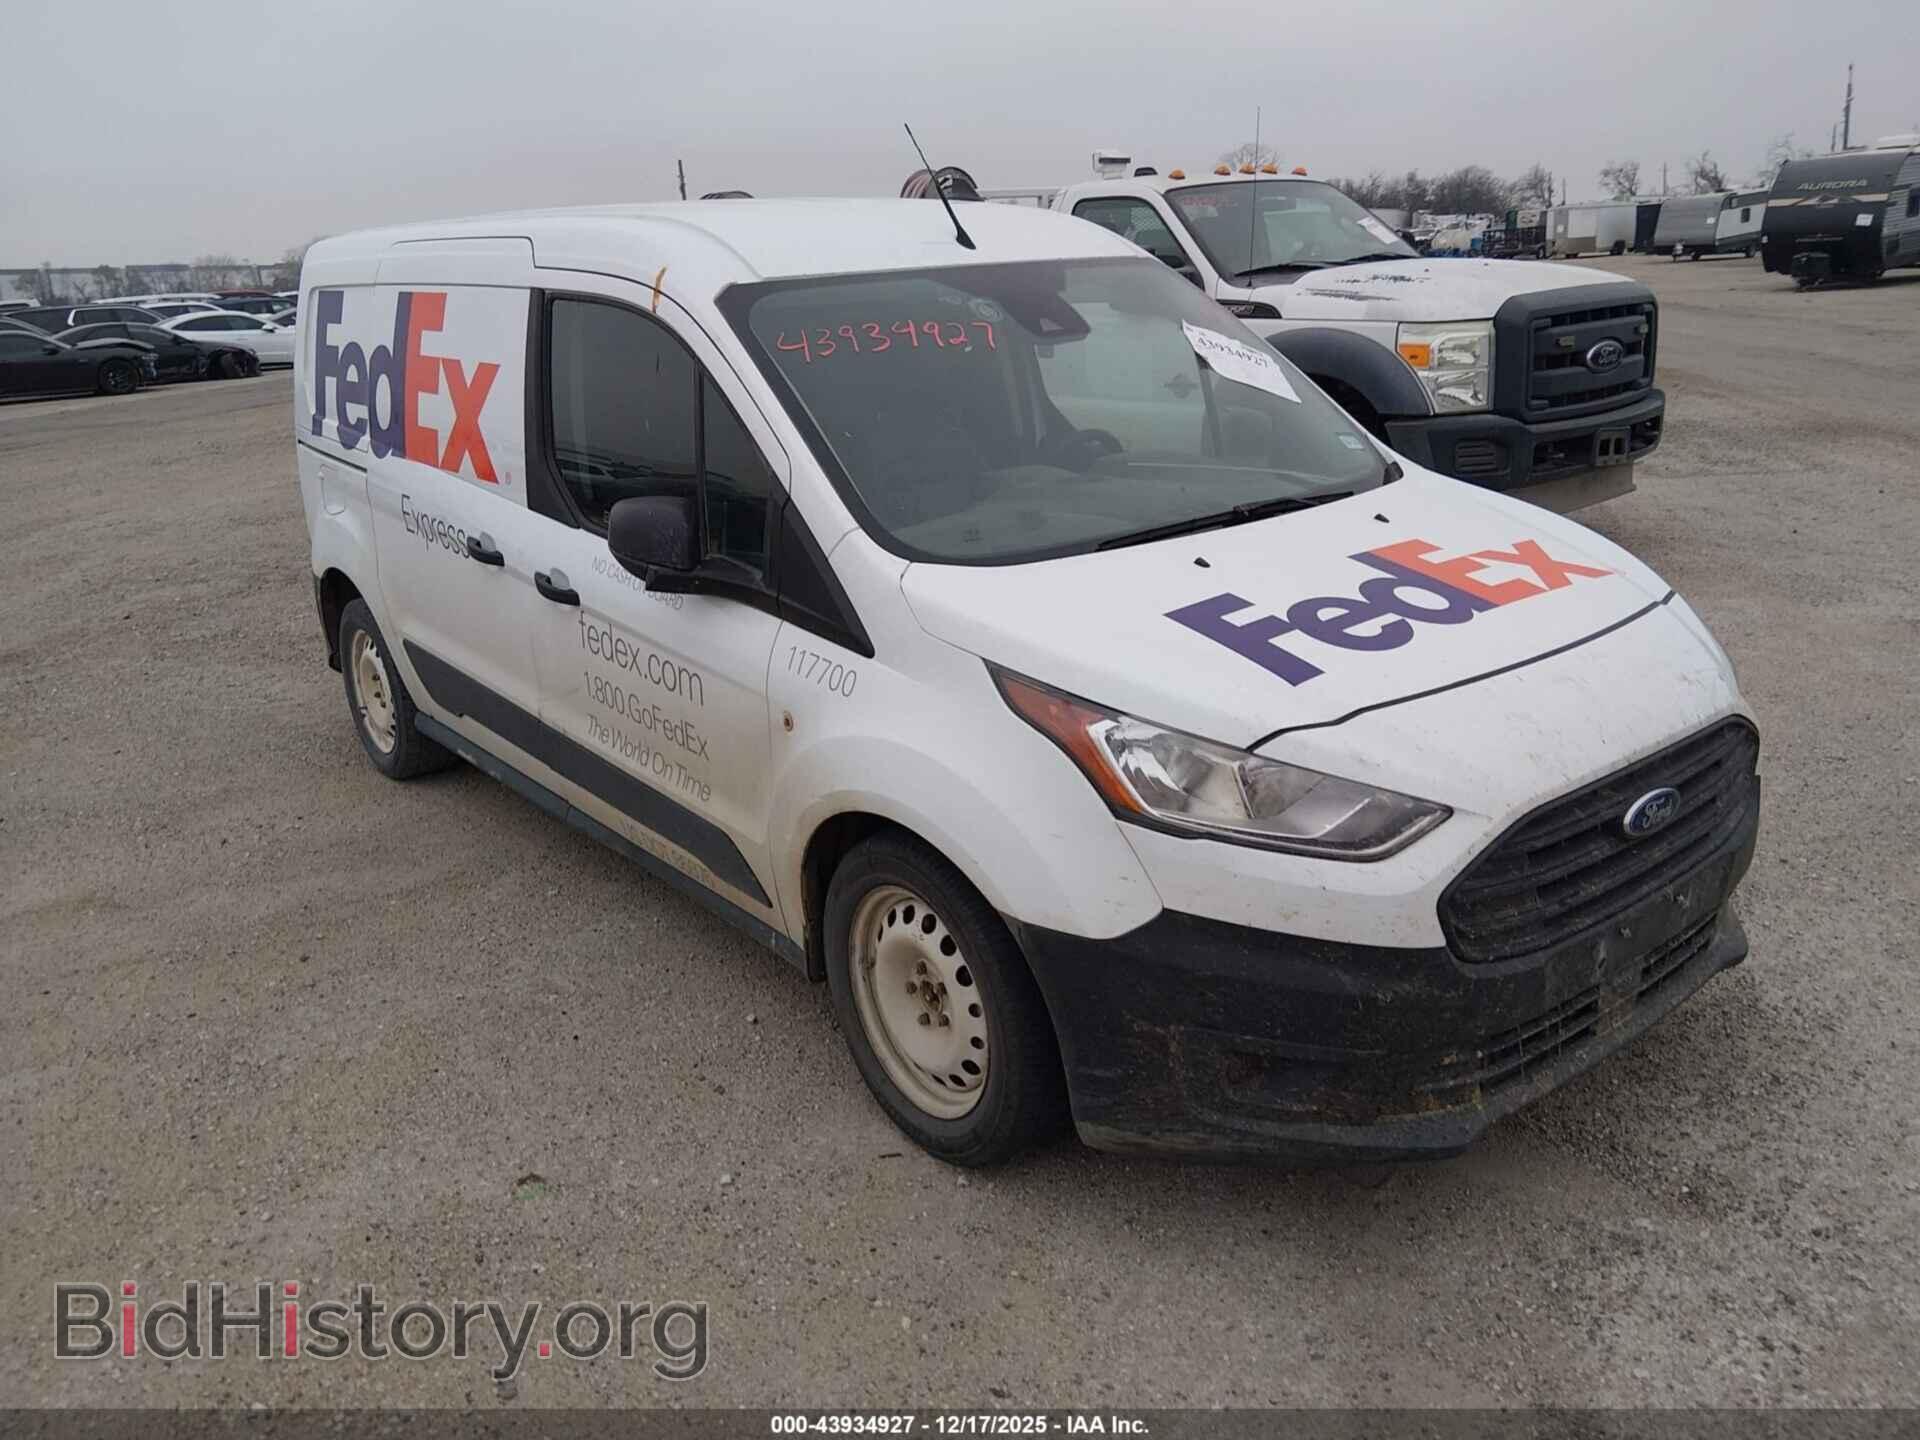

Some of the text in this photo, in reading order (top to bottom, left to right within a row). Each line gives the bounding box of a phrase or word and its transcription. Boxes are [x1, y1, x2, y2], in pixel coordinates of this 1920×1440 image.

[1798, 180, 1867, 191] AURORA
[775, 318, 998, 362] 43934927
[312, 290, 500, 484] FedEx
[401, 494, 471, 559] Express
[592, 555, 608, 574] NO
[1162, 538, 1614, 687] FedEx
[578, 611, 704, 706] fedex.com
[788, 646, 858, 697] 117700
[587, 714, 712, 801] The World On Time
